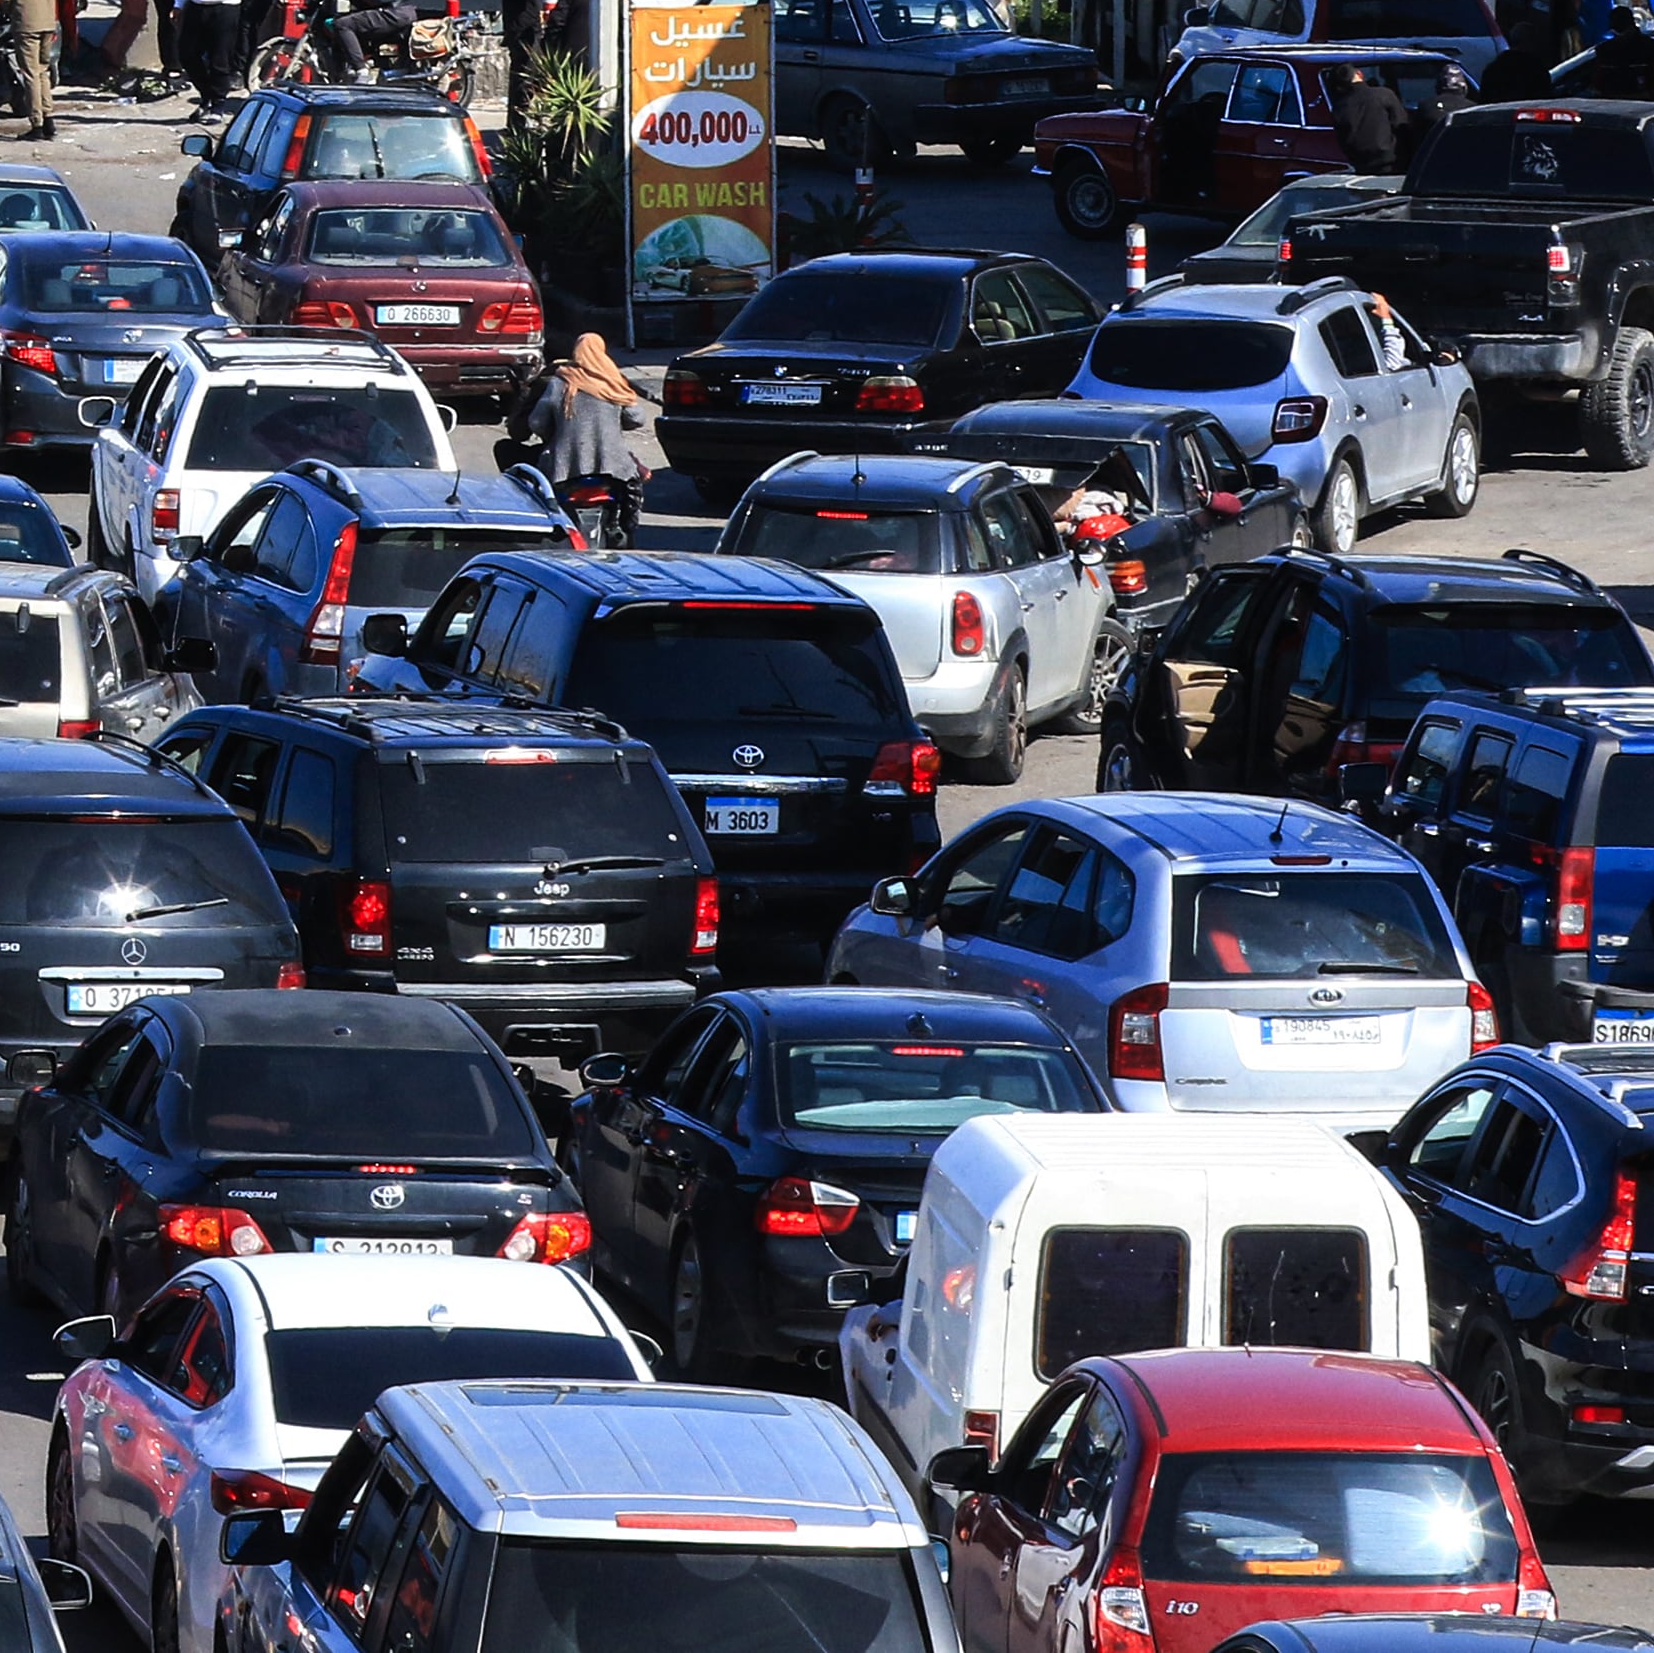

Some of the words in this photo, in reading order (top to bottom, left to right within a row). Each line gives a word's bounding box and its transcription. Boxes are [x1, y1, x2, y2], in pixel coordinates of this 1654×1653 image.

[650, 13, 746, 47] غسيل
[644, 57, 756, 89] سيارات
[638, 111, 748, 147] 400,000
[639, 182, 691, 210] CAR
[696, 180, 766, 210] WASH
[403, 307, 452, 321] 266630
[705, 810, 719, 832] M
[728, 809, 770, 832] 3603
[534, 881, 570, 897] Jeep
[504, 925, 515, 947] N
[529, 925, 593, 948] 156230
[1284, 1018, 1331, 1032] 190845
[228, 1189, 278, 1200] COROLLA
